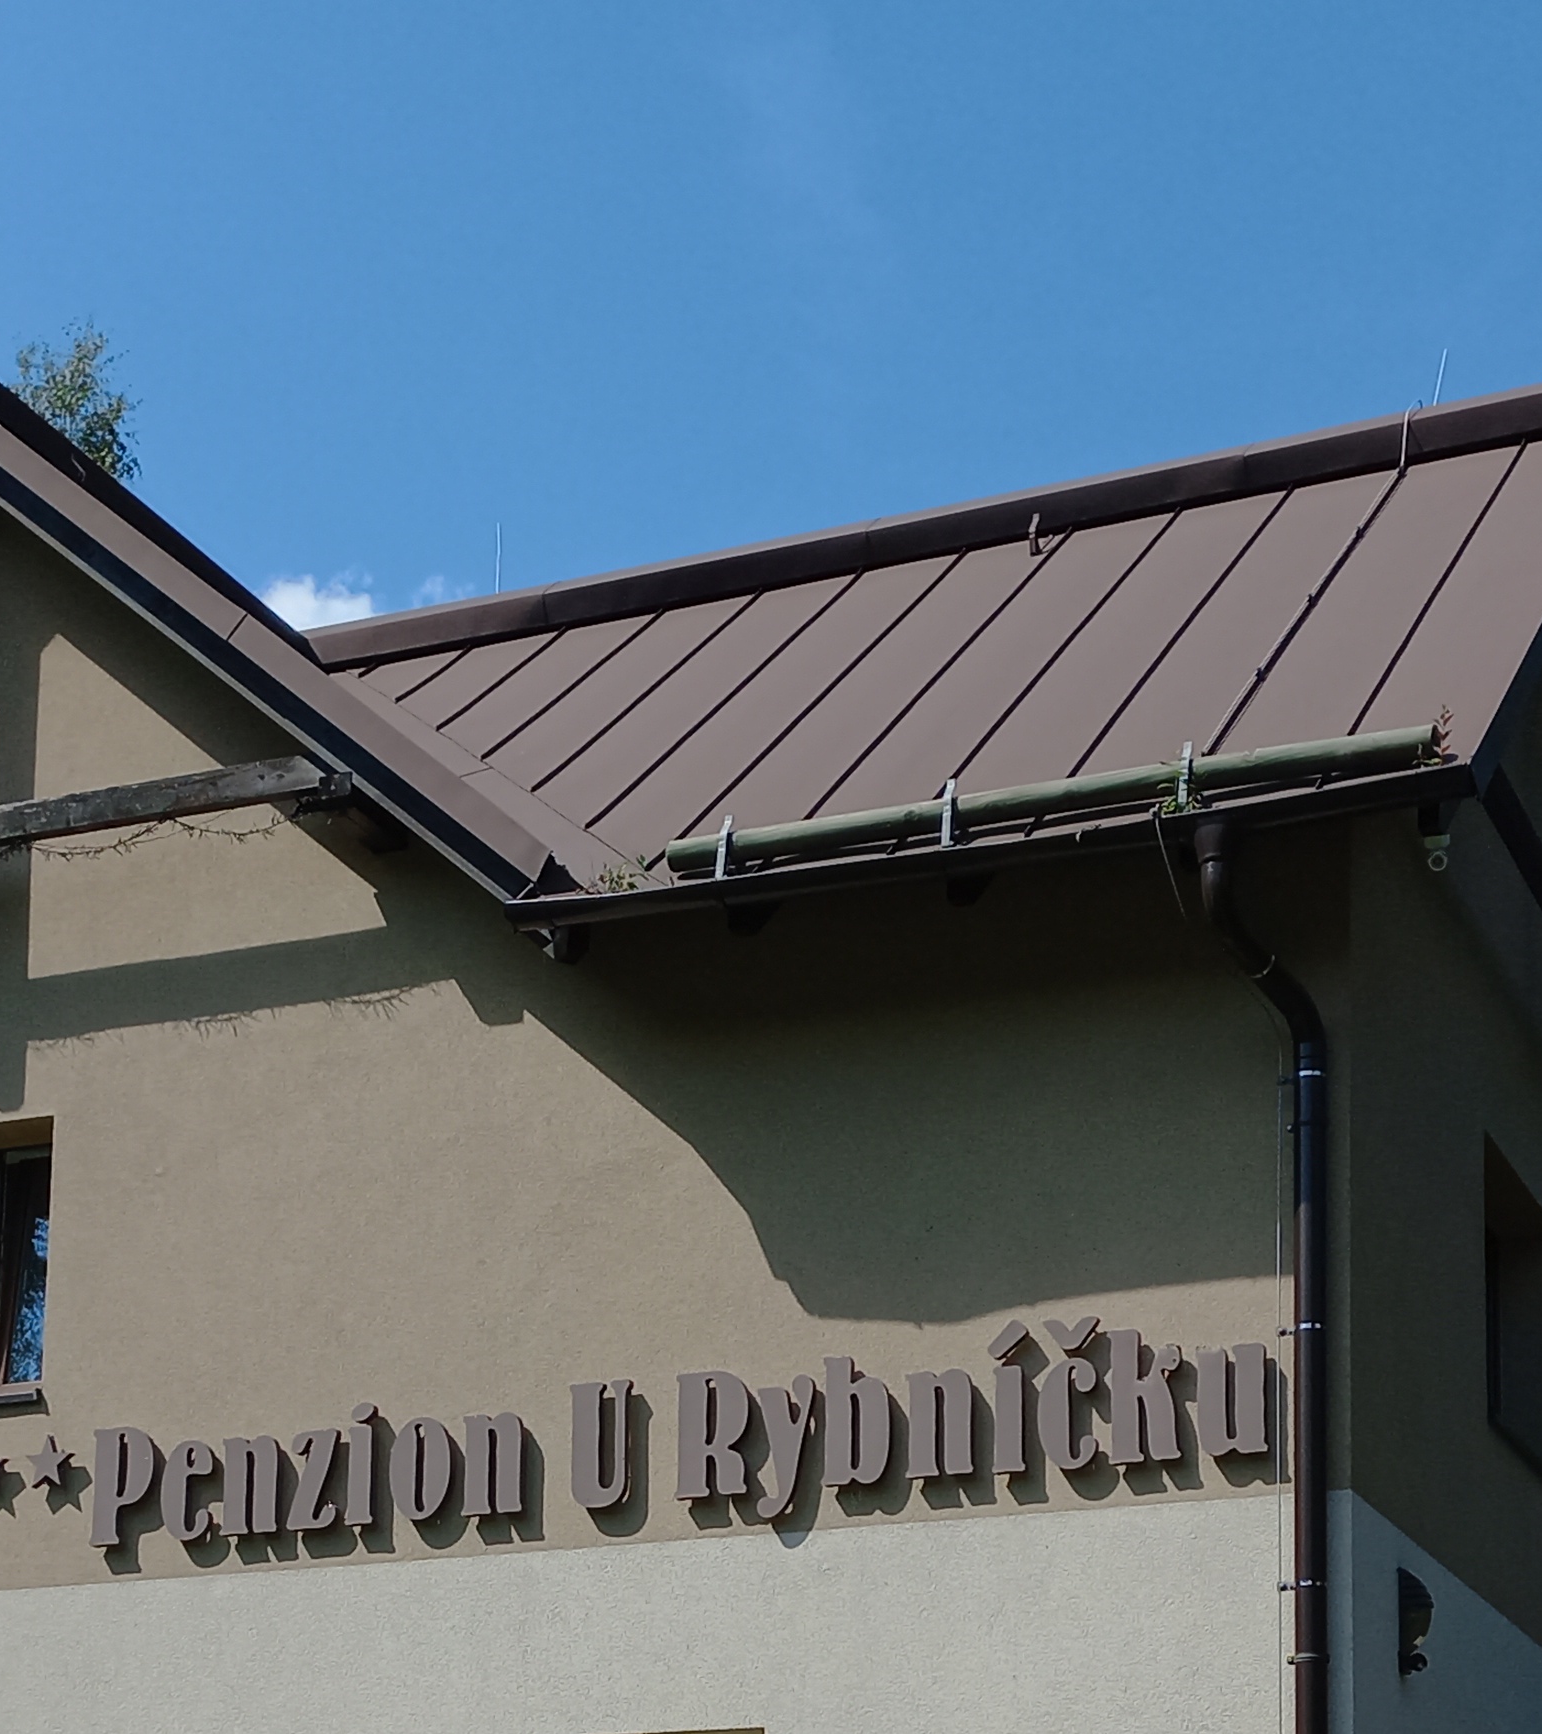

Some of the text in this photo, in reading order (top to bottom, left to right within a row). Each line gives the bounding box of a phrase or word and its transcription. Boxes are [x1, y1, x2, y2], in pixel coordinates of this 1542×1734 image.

[89, 1316, 1269, 1547] Penzion U Rybníčku
